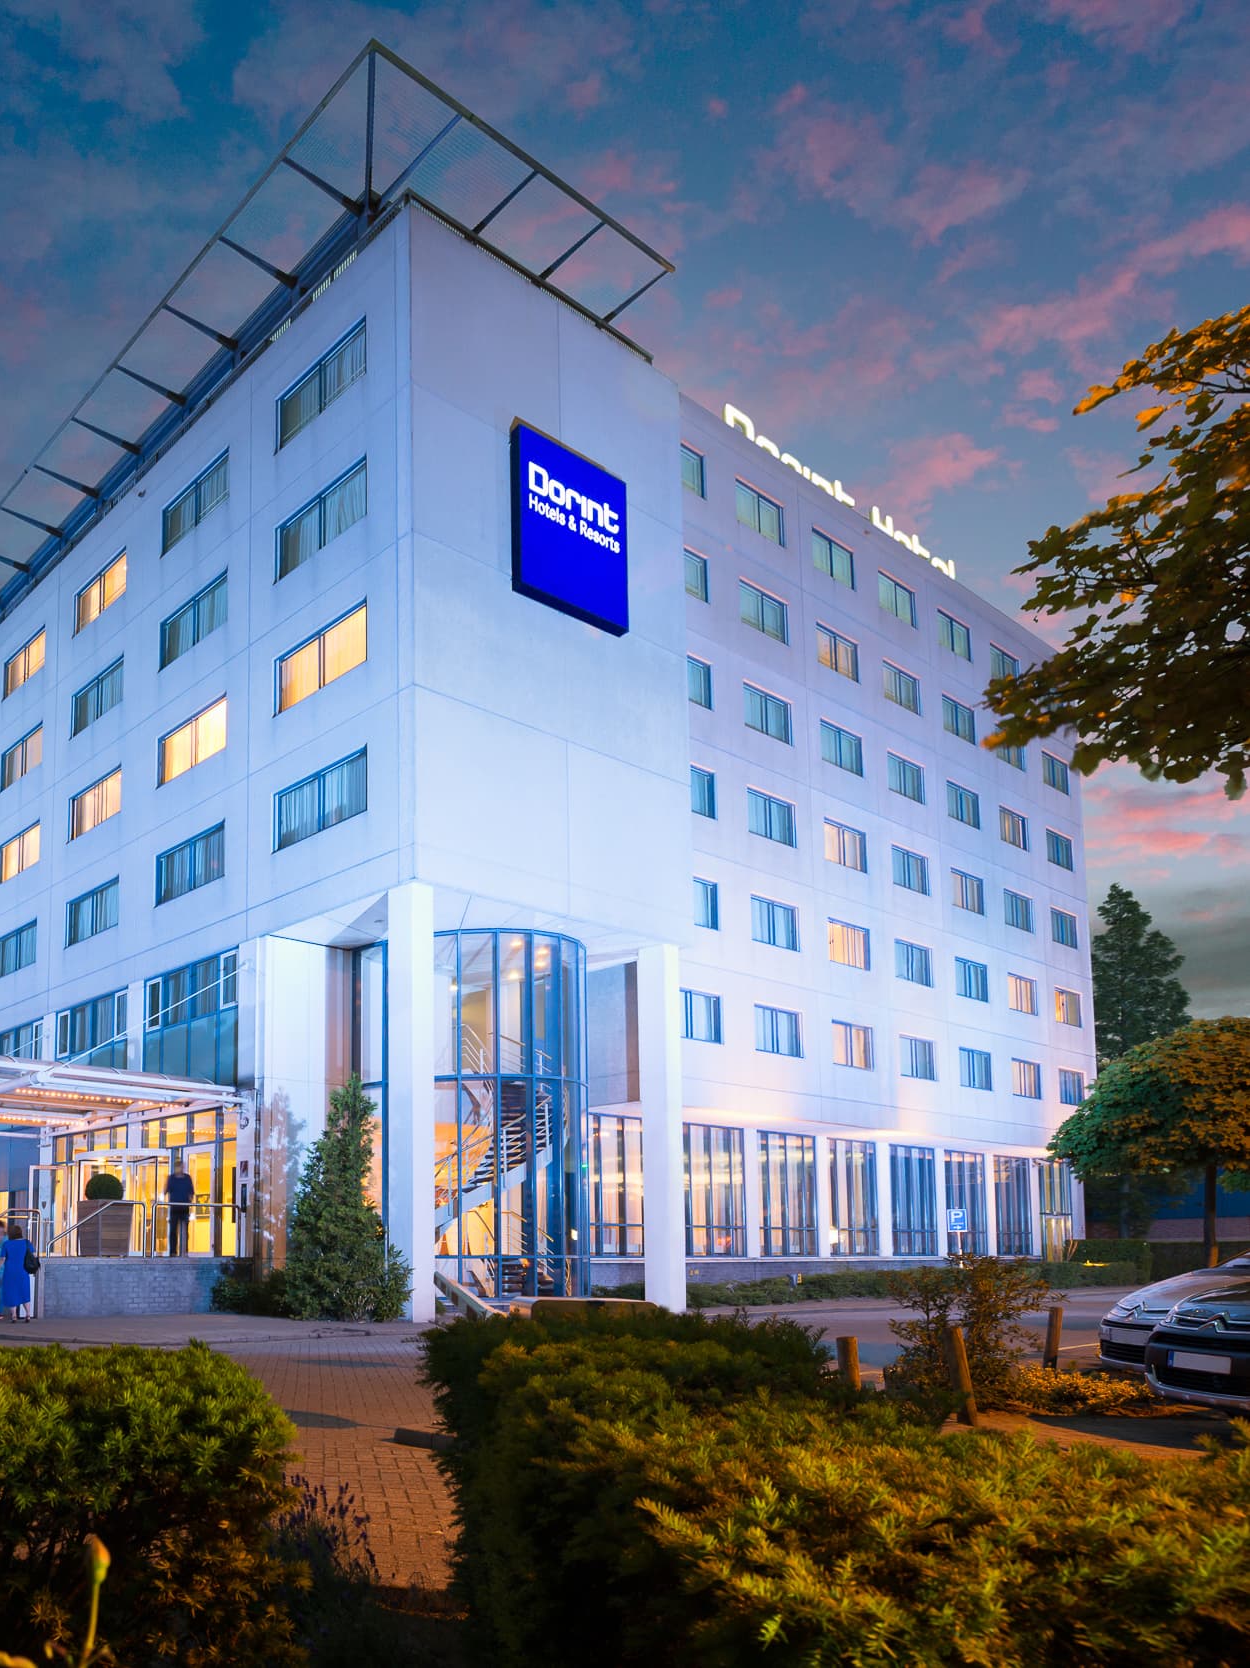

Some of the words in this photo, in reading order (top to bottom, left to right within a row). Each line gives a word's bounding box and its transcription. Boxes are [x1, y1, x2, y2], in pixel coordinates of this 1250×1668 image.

[529, 461, 619, 534] Dorint
[529, 492, 566, 526] Hotels
[568, 514, 577, 532] &
[580, 519, 620, 554] Resorts
[951, 1211, 963, 1222] P
